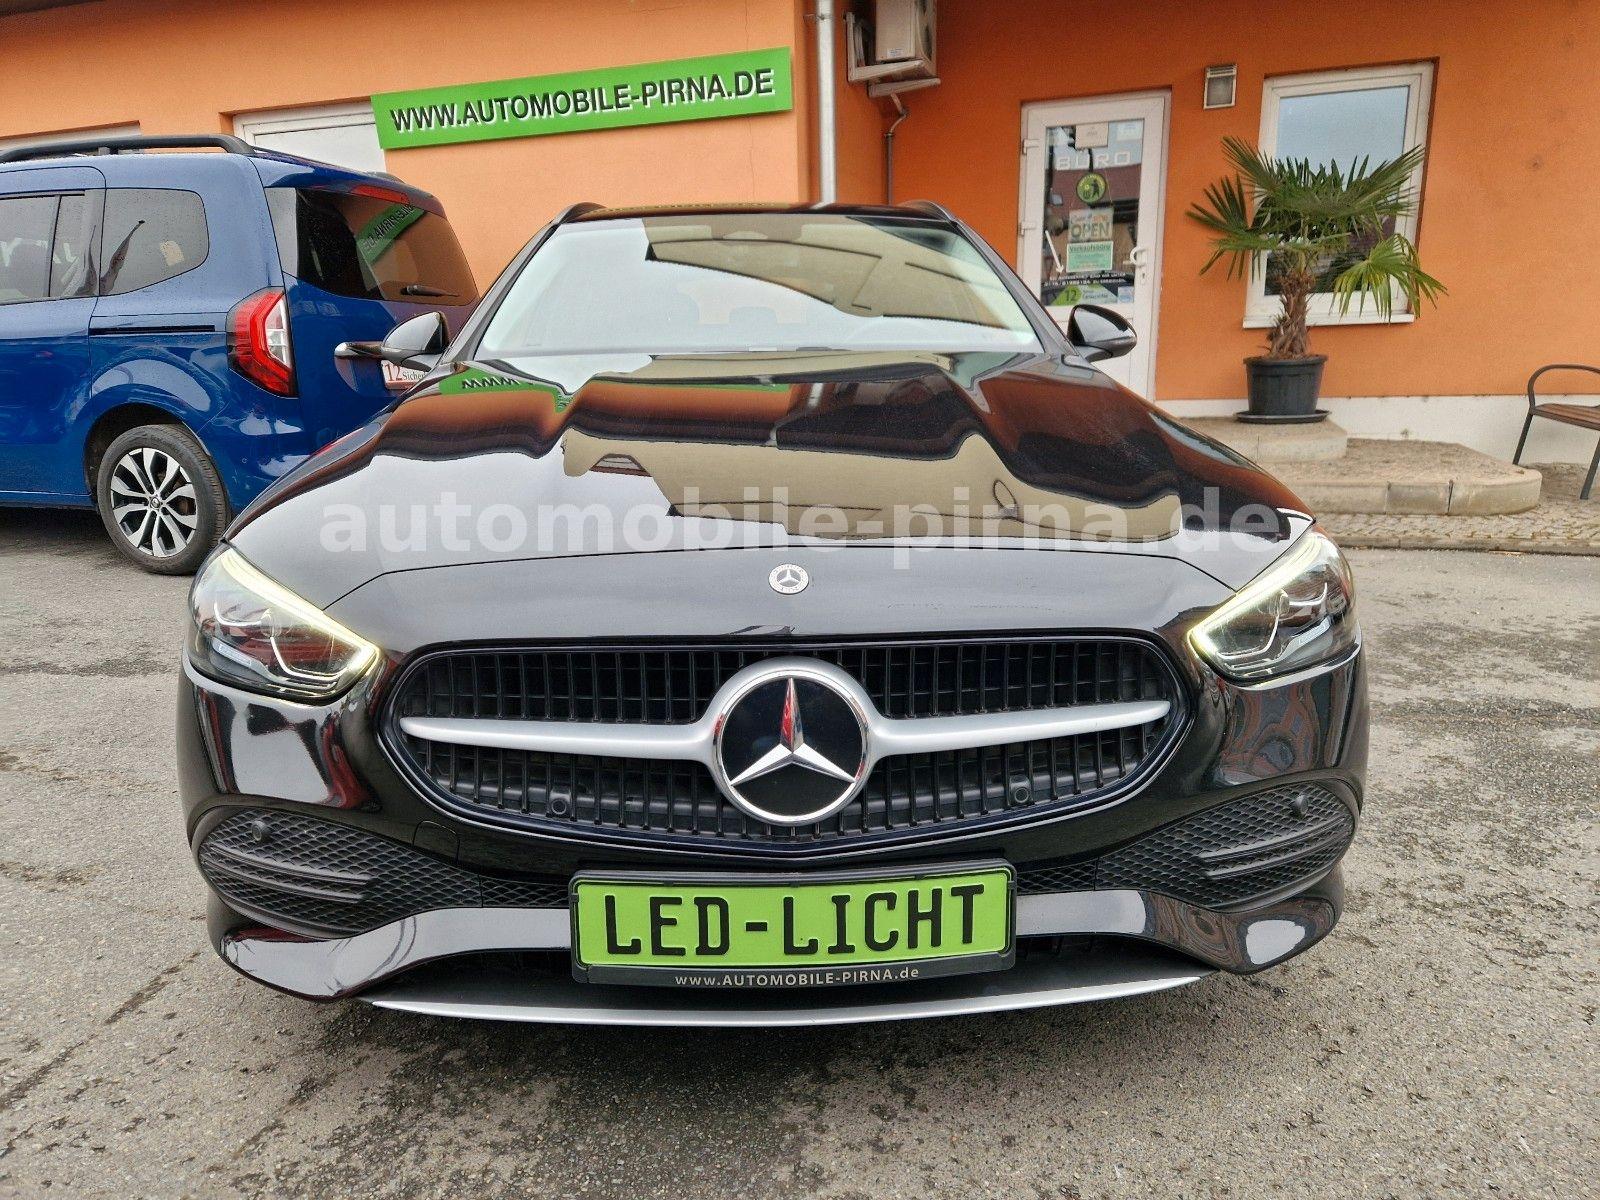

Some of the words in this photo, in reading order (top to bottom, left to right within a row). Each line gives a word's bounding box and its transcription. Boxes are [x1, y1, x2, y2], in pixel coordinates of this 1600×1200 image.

[390, 68, 774, 133] WWW.AUTOMOBILE-PIRNA.DE
[1071, 221, 1110, 238] OPEN
[1066, 289, 1077, 301] 12
[385, 363, 402, 381] 12
[675, 967, 920, 988] www.AUTOMOBILE-PIRNA.de
